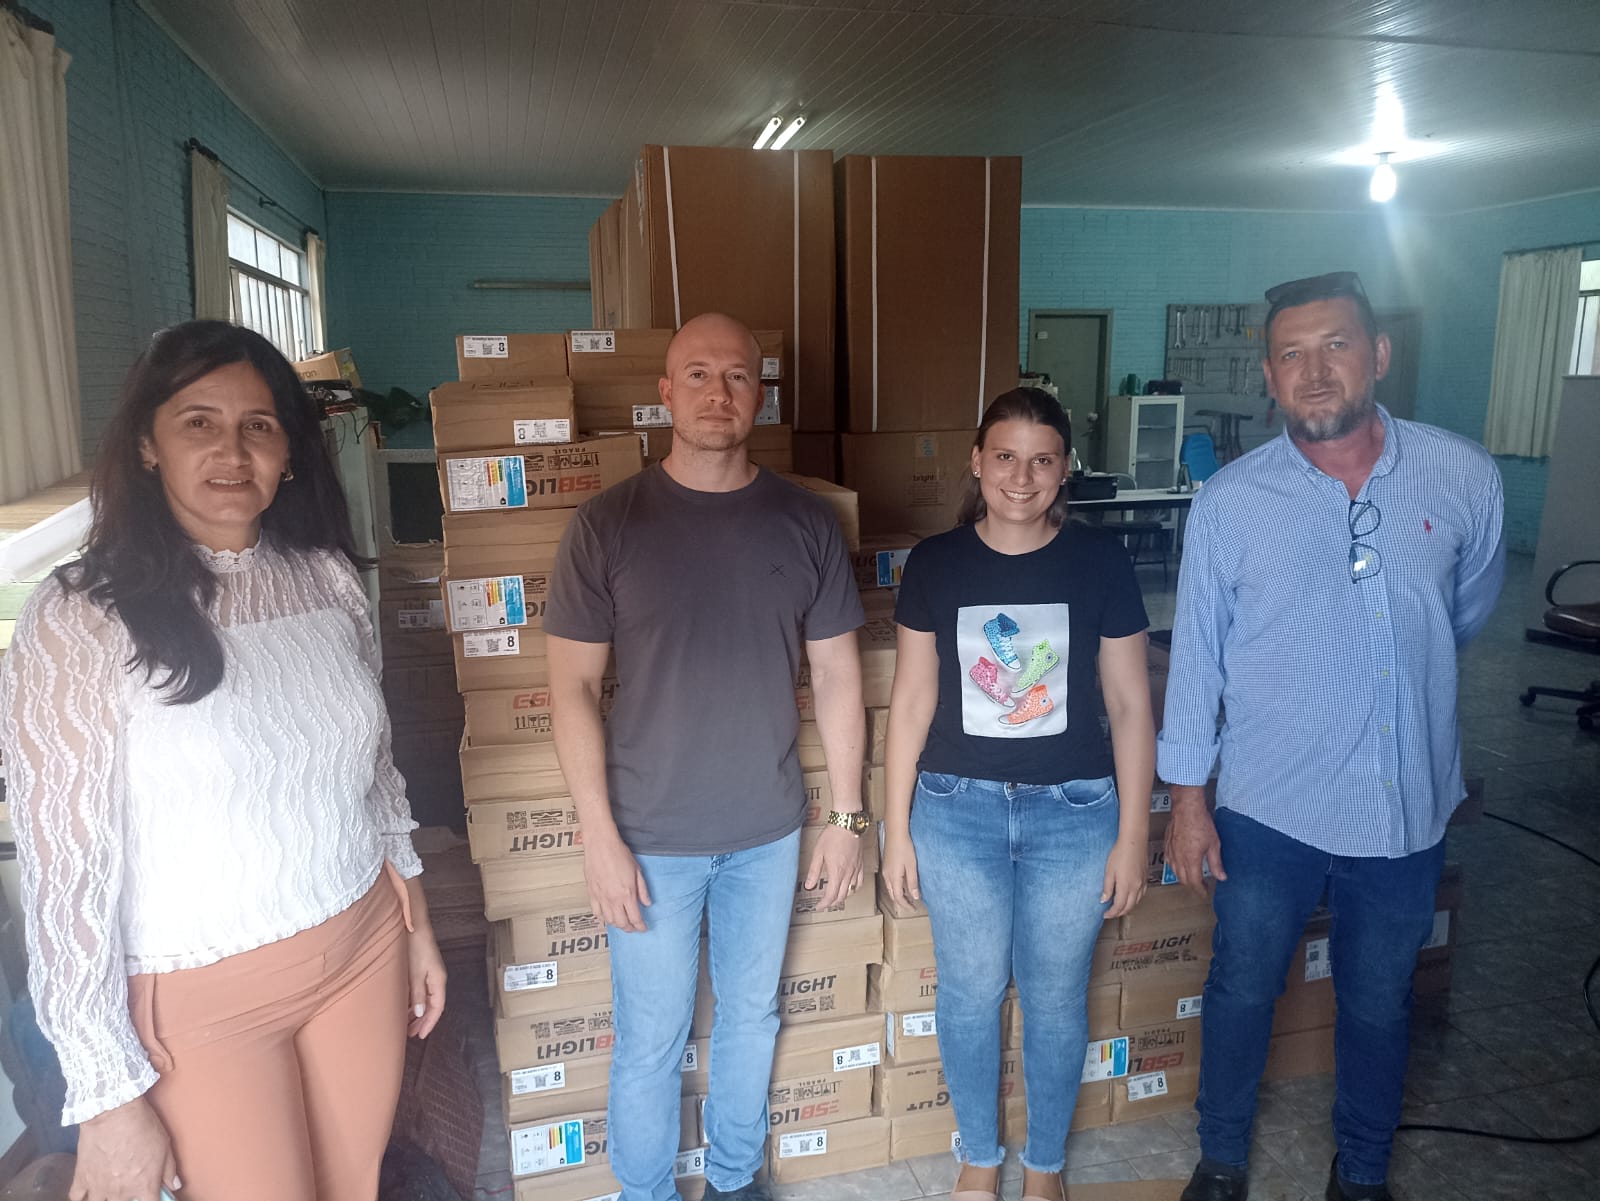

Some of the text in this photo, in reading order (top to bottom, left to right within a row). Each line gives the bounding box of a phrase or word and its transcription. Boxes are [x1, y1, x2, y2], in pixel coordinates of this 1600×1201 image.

[636, 411, 643, 422] 8
[507, 636, 515, 648] 8
[1163, 795, 1169, 806] 8
[546, 968, 554, 980] 8
[1179, 1003, 1186, 1013] 8
[686, 1052, 694, 1064] 8
[836, 1055, 844, 1065] 8
[554, 1070, 561, 1082] 8
[1157, 1077, 1164, 1088] 8
[816, 1136, 824, 1147] 8
[954, 1137, 961, 1147] 8
[694, 1156, 701, 1168] 8
